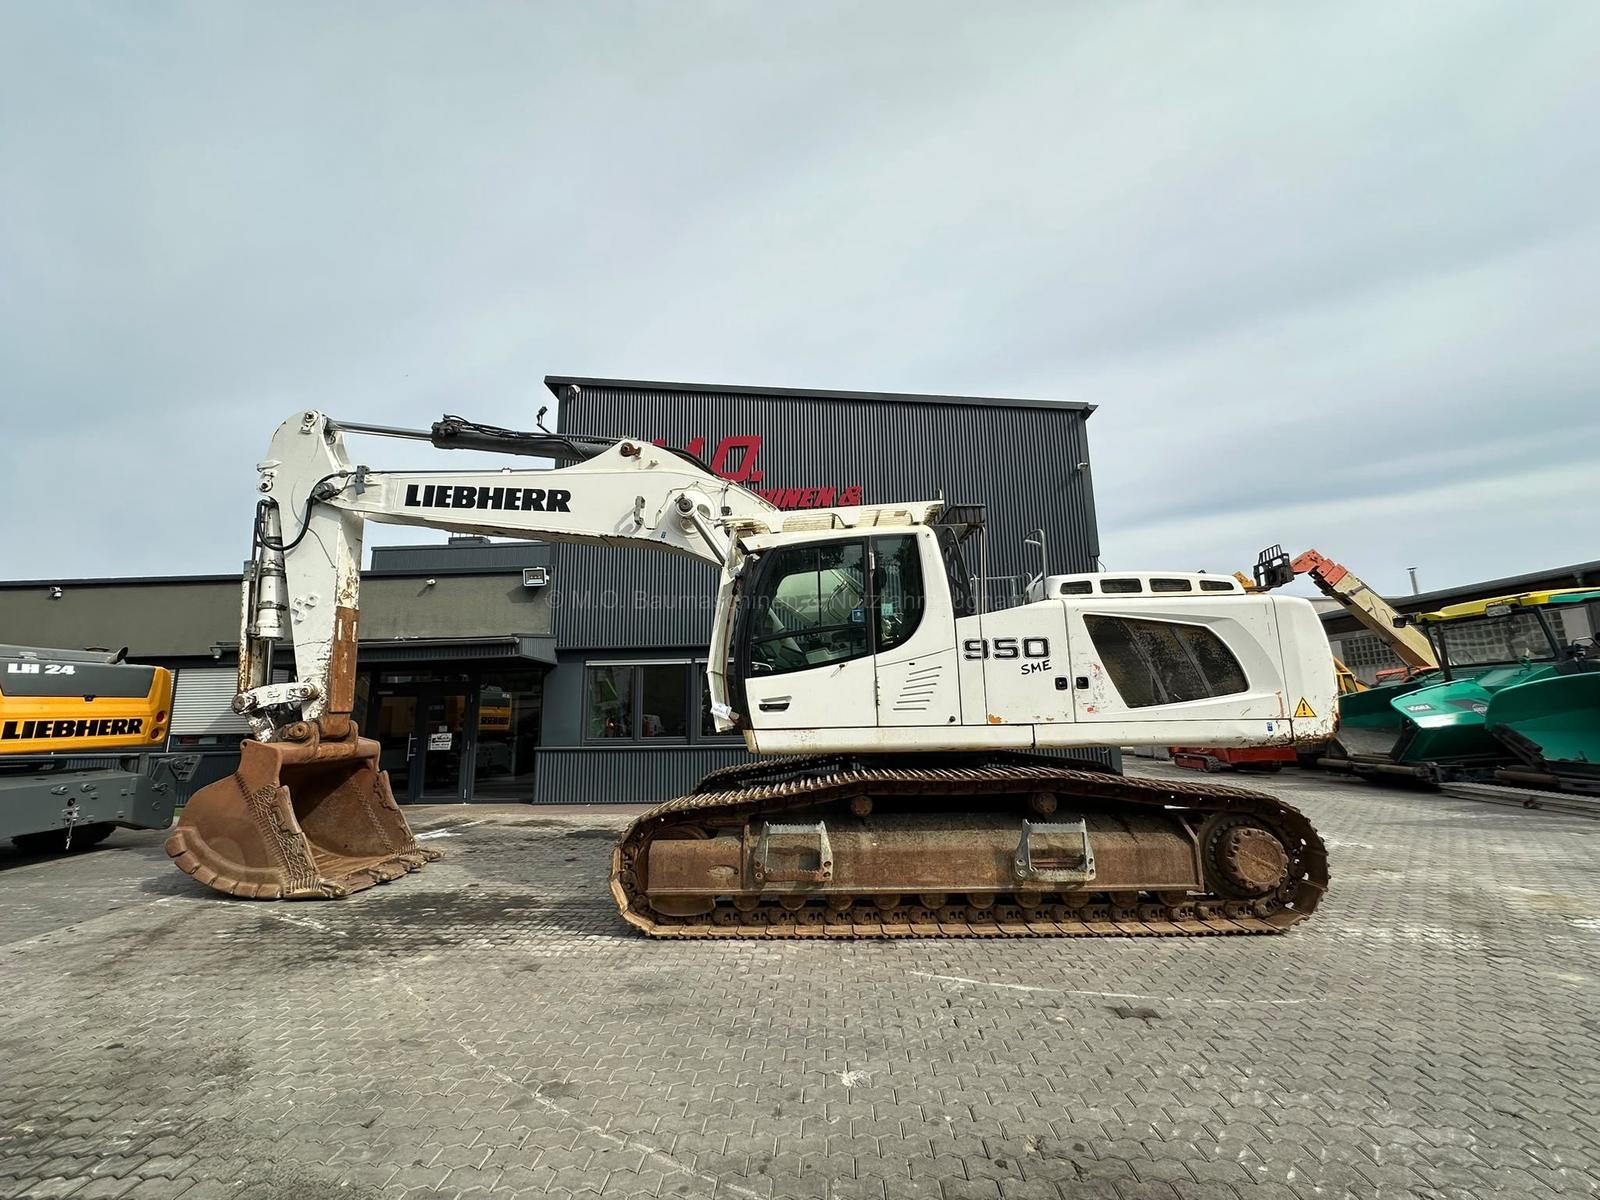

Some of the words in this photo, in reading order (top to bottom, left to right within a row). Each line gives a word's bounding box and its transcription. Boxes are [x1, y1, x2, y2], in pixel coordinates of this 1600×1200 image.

[404, 484, 571, 513] LIEBHERR
[838, 486, 862, 507] &
[962, 637, 1050, 660] 950
[8, 663, 39, 674] LH
[44, 664, 75, 675] 24
[1021, 660, 1052, 675] SME
[1, 718, 143, 740] LIEBHERR
